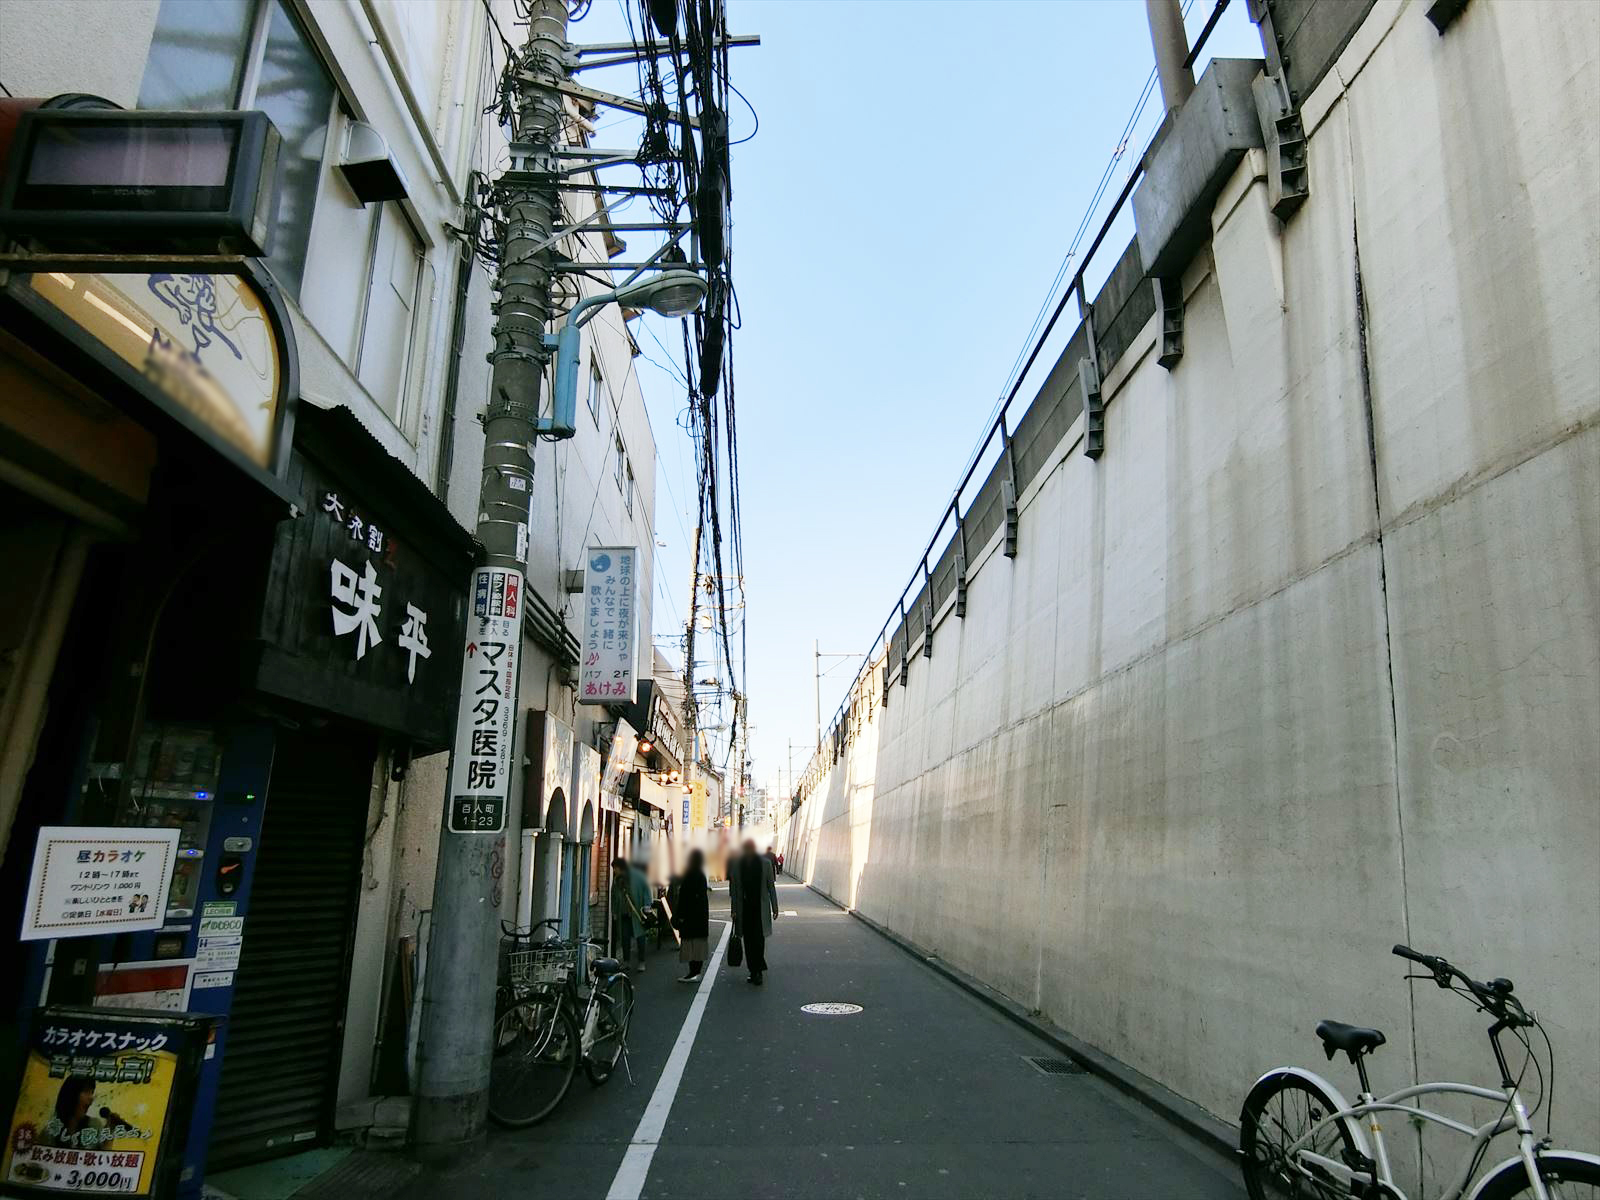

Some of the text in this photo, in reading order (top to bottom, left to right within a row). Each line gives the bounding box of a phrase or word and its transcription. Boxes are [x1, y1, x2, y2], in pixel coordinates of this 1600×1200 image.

[506, 575, 518, 617] 婦人科
[331, 558, 433, 685] 味平
[588, 585, 602, 650] 歌いましょう
[603, 575, 616, 650] みんなで一緒に
[613, 670, 629, 679] 2F
[585, 681, 626, 696] あけみ
[467, 641, 506, 790] マスダ医院
[462, 803, 494, 814] 百人町
[463, 816, 493, 826] 1-23
[76, 849, 147, 863] 昼カラオケ
[43, 1025, 169, 1051] カラオケスナック
[67, 1169, 132, 1189] 3,000円
